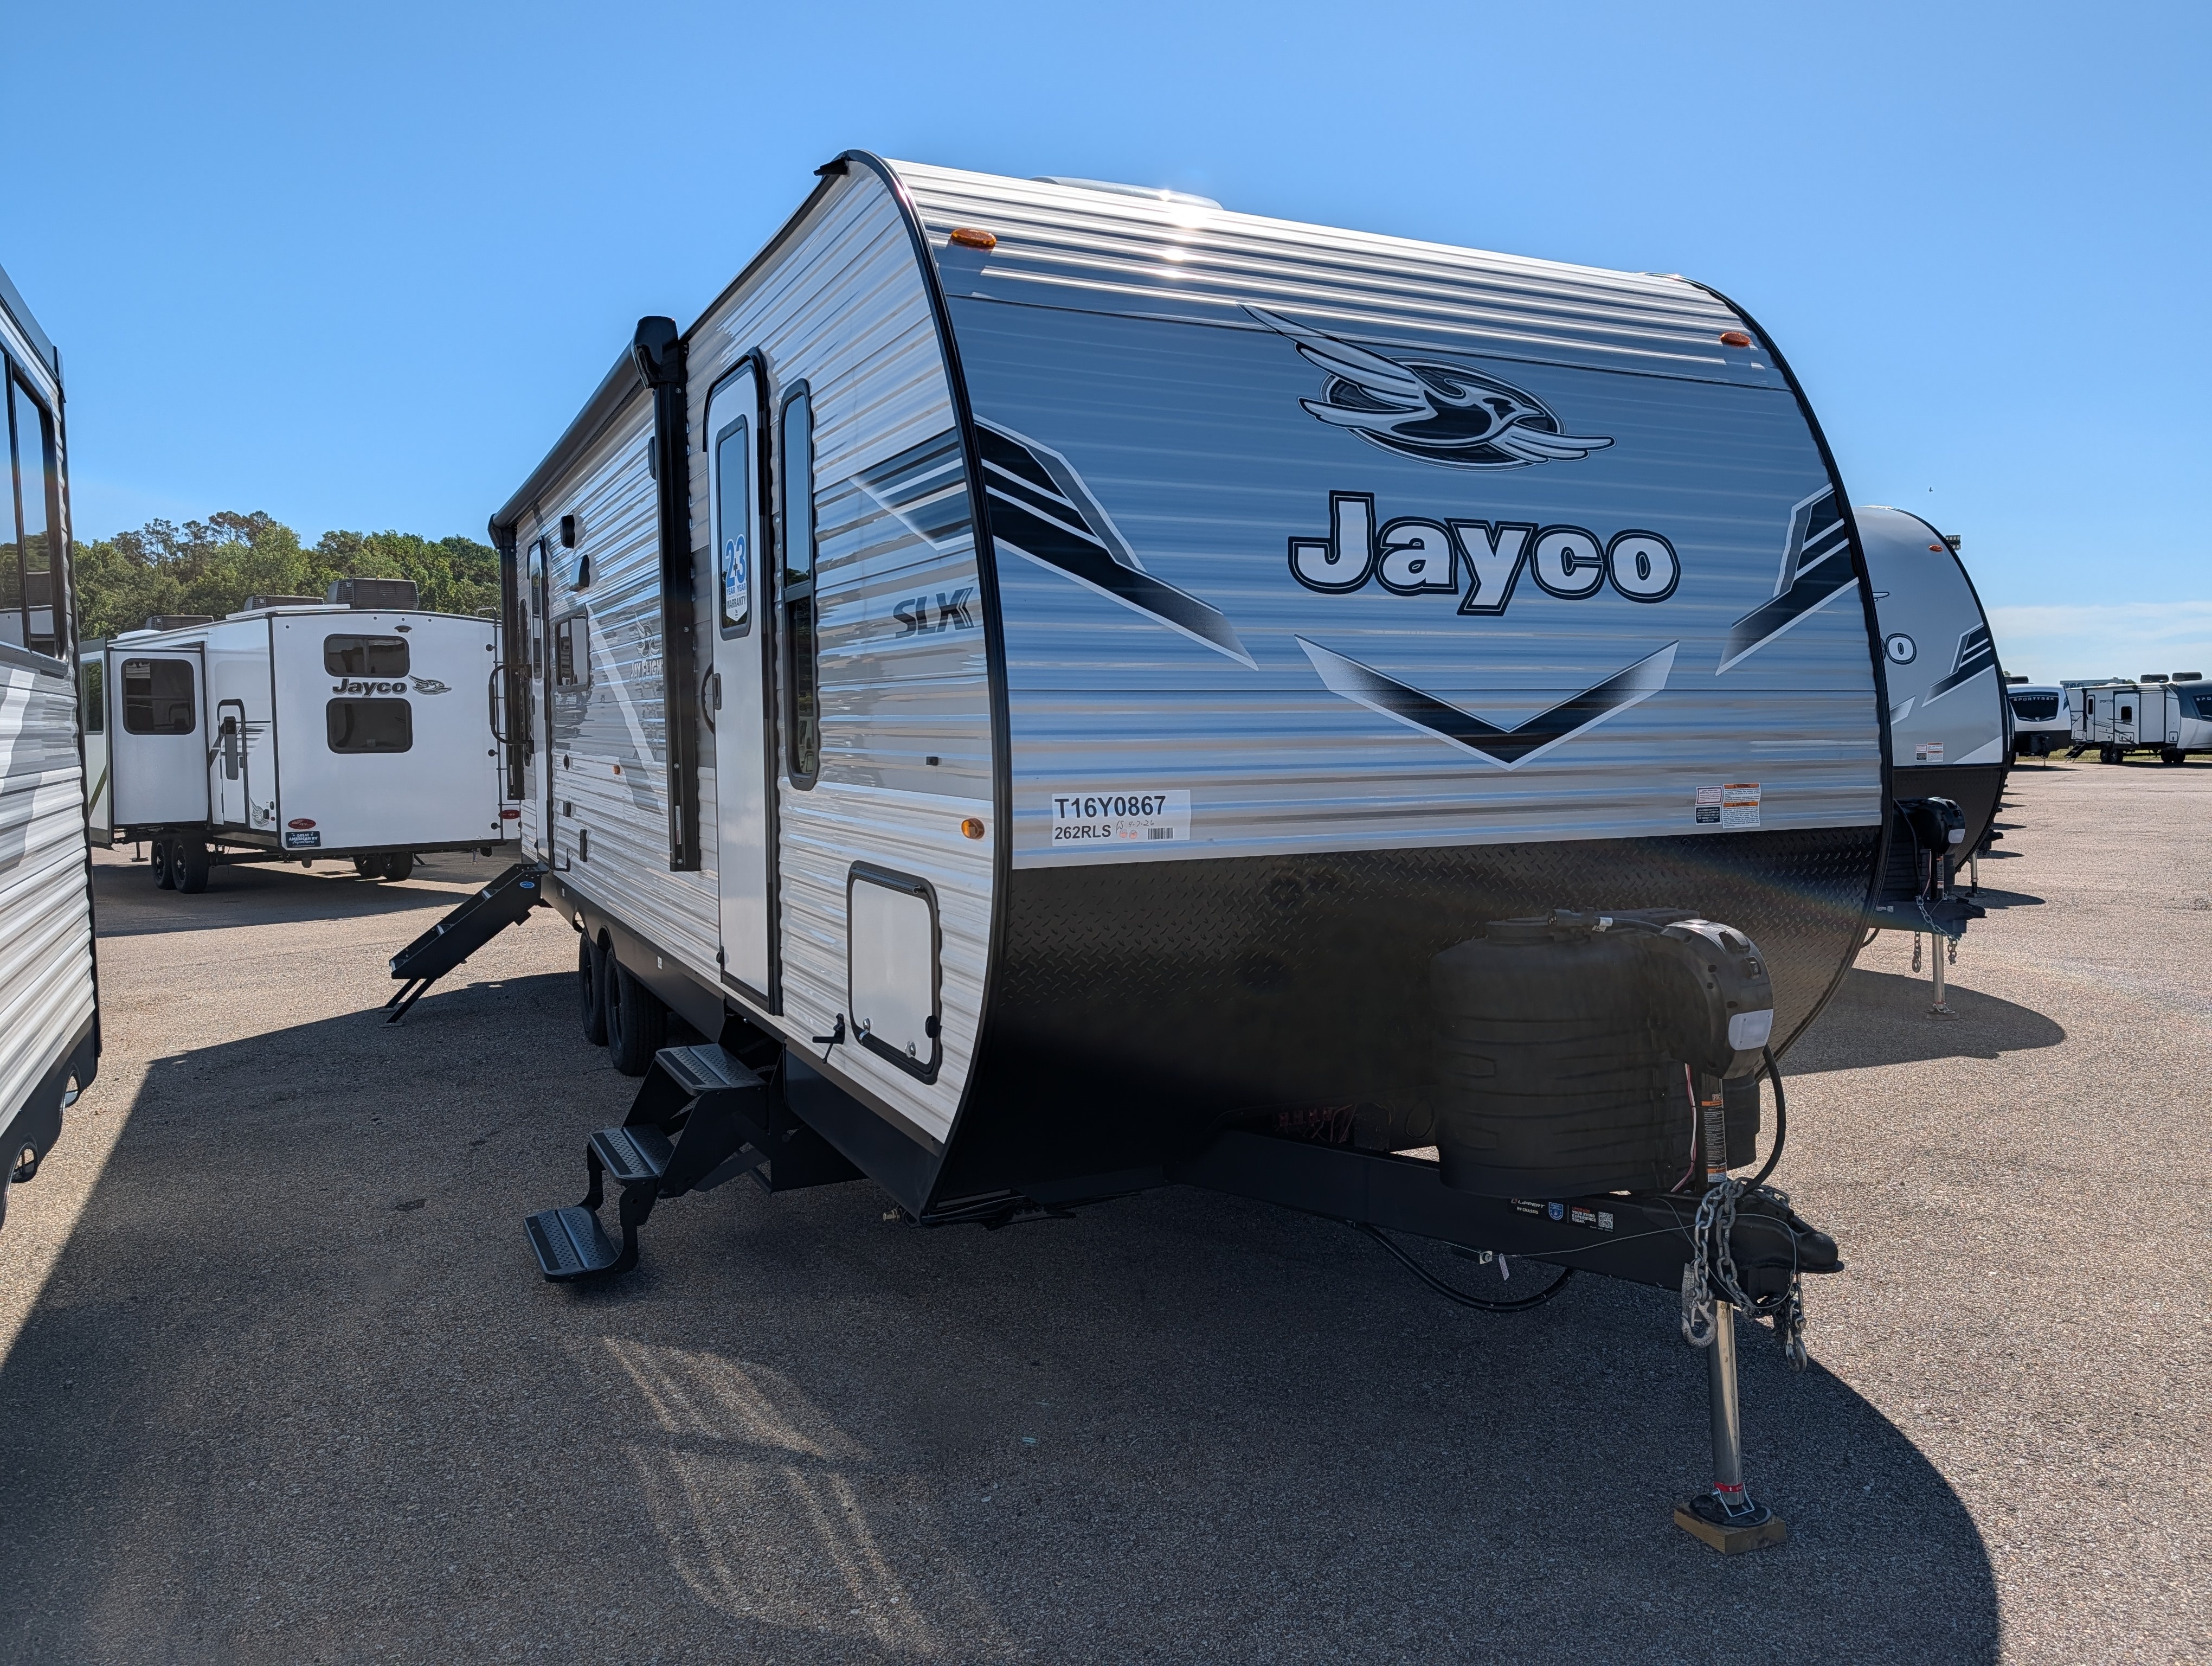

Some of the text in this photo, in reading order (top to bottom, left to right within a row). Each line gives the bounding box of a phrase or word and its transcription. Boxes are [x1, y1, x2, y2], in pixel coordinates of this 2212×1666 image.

[1288, 490, 1681, 616] Jayco
[726, 586, 735, 595] YEAR
[737, 583, 746, 592] YEAR
[727, 595, 746, 610] WARRANTY
[893, 587, 974, 638] SLX
[642, 658, 663, 678] FLIGH
[332, 678, 408, 697] Jayco
[1054, 796, 1166, 818] T16Y0867
[1054, 824, 1111, 840] 262RLS
[1572, 1214, 1597, 1222] EXPERIENCE
